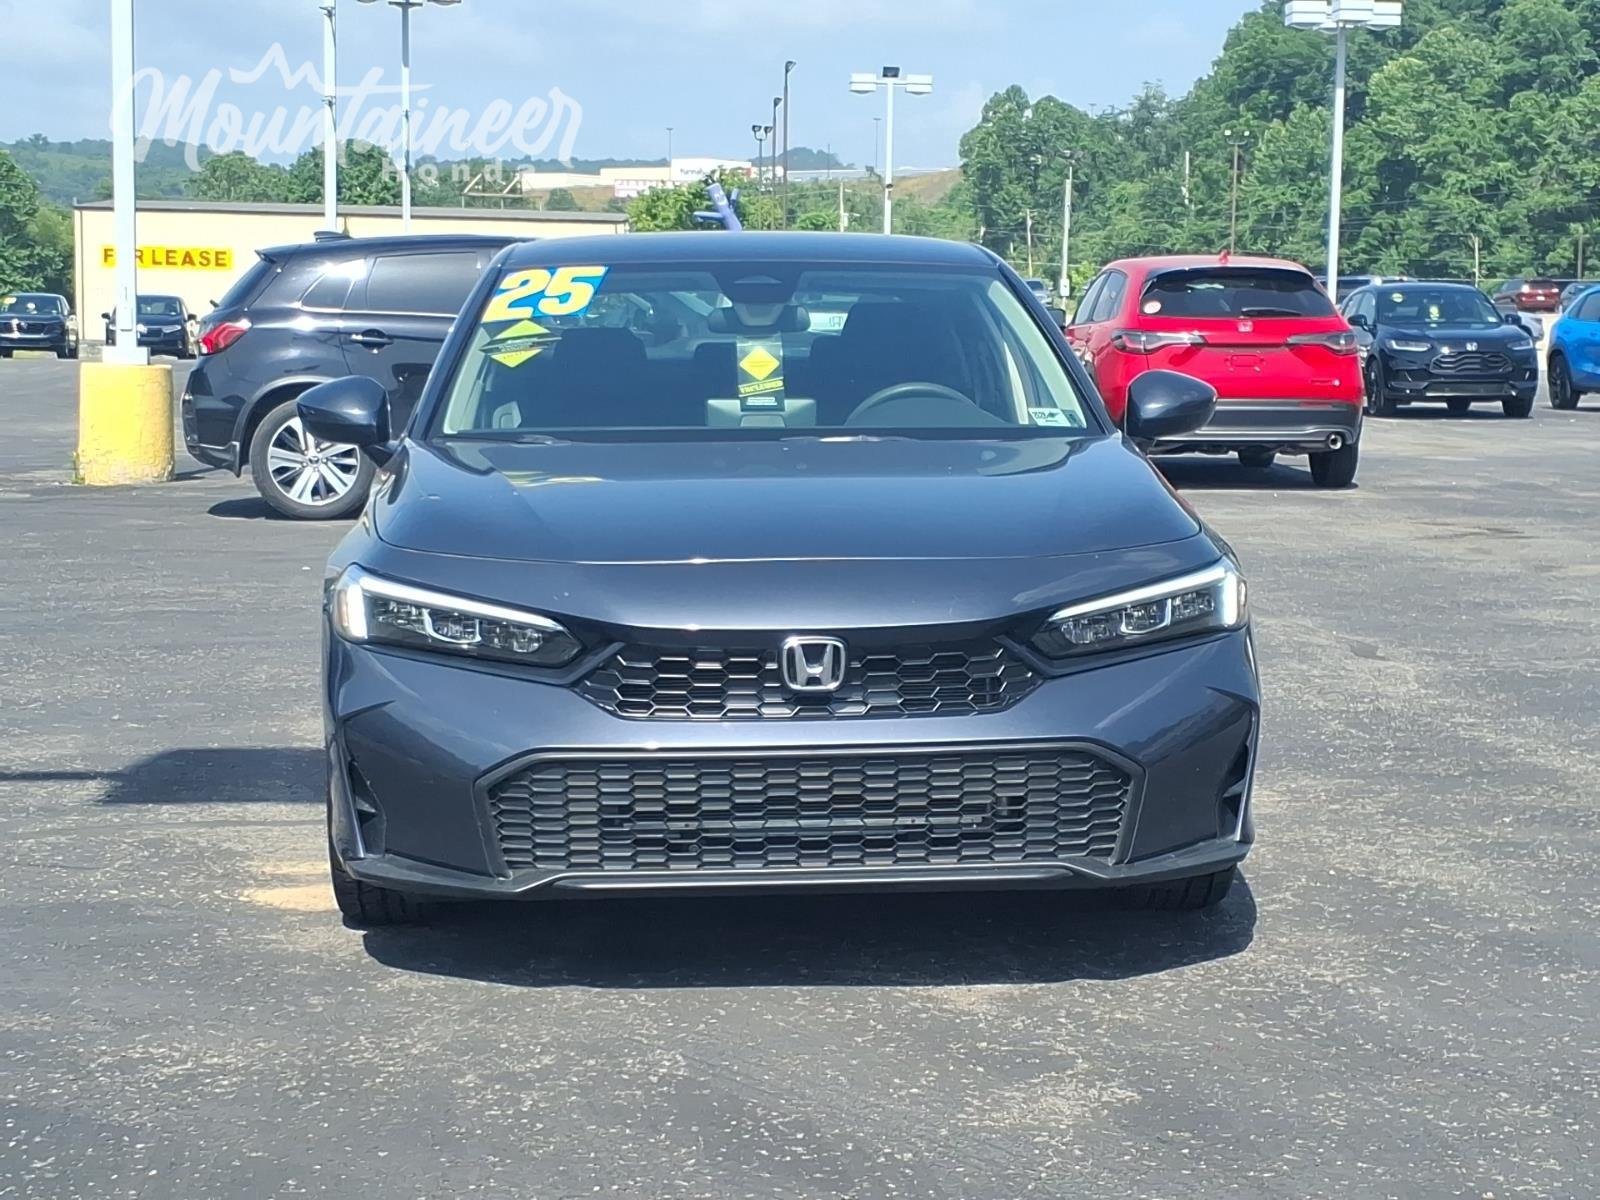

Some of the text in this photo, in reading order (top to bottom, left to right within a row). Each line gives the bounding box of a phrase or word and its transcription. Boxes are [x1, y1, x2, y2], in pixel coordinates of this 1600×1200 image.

[103, 247, 227, 267] FR LEASE
[481, 266, 606, 323] 25
